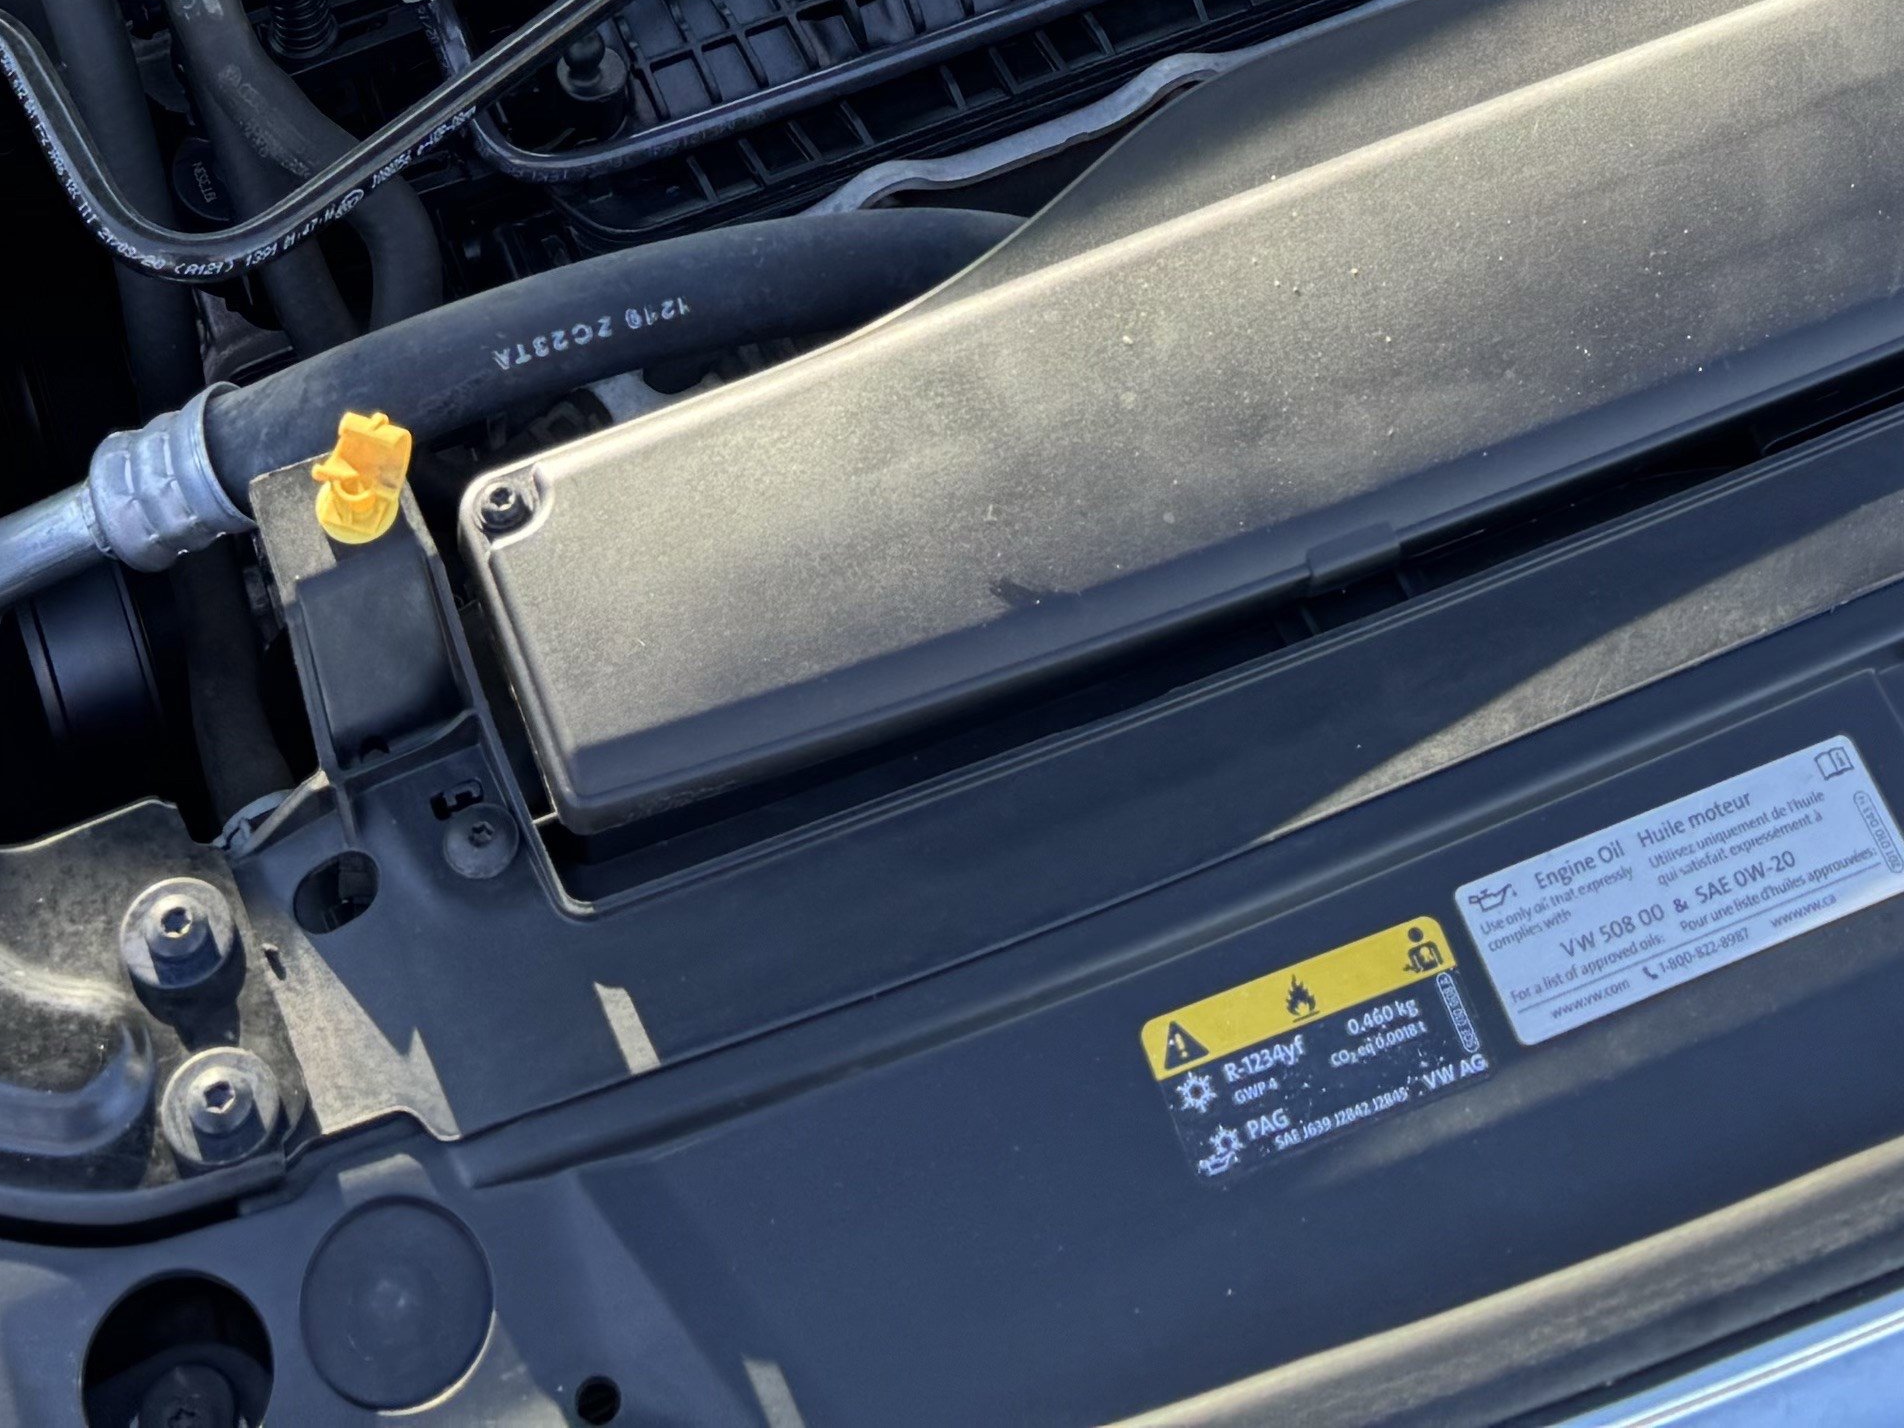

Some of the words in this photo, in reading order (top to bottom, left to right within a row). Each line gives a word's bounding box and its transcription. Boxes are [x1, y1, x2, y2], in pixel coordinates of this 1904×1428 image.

[1635, 815, 1688, 849] Huile
[1685, 790, 1754, 829] moteur
[1647, 840, 1696, 869] Utilisez
[1694, 810, 1771, 852] uniquement
[1768, 803, 1788, 820] de
[1532, 851, 1600, 894] Engine
[1595, 840, 1626, 865] Oil
[1655, 866, 1681, 887] qui
[1678, 847, 1728, 876] satisfait
[1810, 808, 1823, 822] à
[1478, 916, 1504, 936] Use
[1500, 904, 1533, 929] only
[1548, 886, 1578, 907] that
[1575, 863, 1635, 898] expressly
[1559, 930, 1599, 959] VW
[1597, 914, 1637, 943] 508
[1635, 902, 1666, 928] 00
[1670, 894, 1690, 914] &
[1692, 876, 1733, 904] SAE
[1730, 848, 1798, 889] 0W-20
[1679, 911, 1711, 934] Pour
[1708, 903, 1734, 922] une
[1731, 890, 1760, 912] liste
[1769, 892, 1838, 930] www.vw.ca
[1485, 919, 1545, 955] complies
[1541, 907, 1574, 930] with
[1657, 925, 1752, 975] 1-800-822-8987
[1508, 983, 1534, 1004] For
[1532, 981, 1544, 995] a
[1540, 971, 1563, 991] list
[1559, 964, 1580, 983] of
[1577, 940, 1640, 977] approved
[1344, 1002, 1397, 1036] 0.460
[1393, 994, 1420, 1021] kg
[1548, 976, 1631, 1021] www.vw.com
[1220, 1034, 1310, 1088] R-1234yf
[1421, 1063, 1458, 1091] VW
[1455, 1050, 1489, 1078] AG
[1233, 1080, 1269, 1105] GWP
[1266, 1076, 1279, 1092] 4
[1244, 1107, 1291, 1141] PAG
[1272, 1127, 1302, 1151] SAE
[1300, 1115, 1334, 1140] J639
